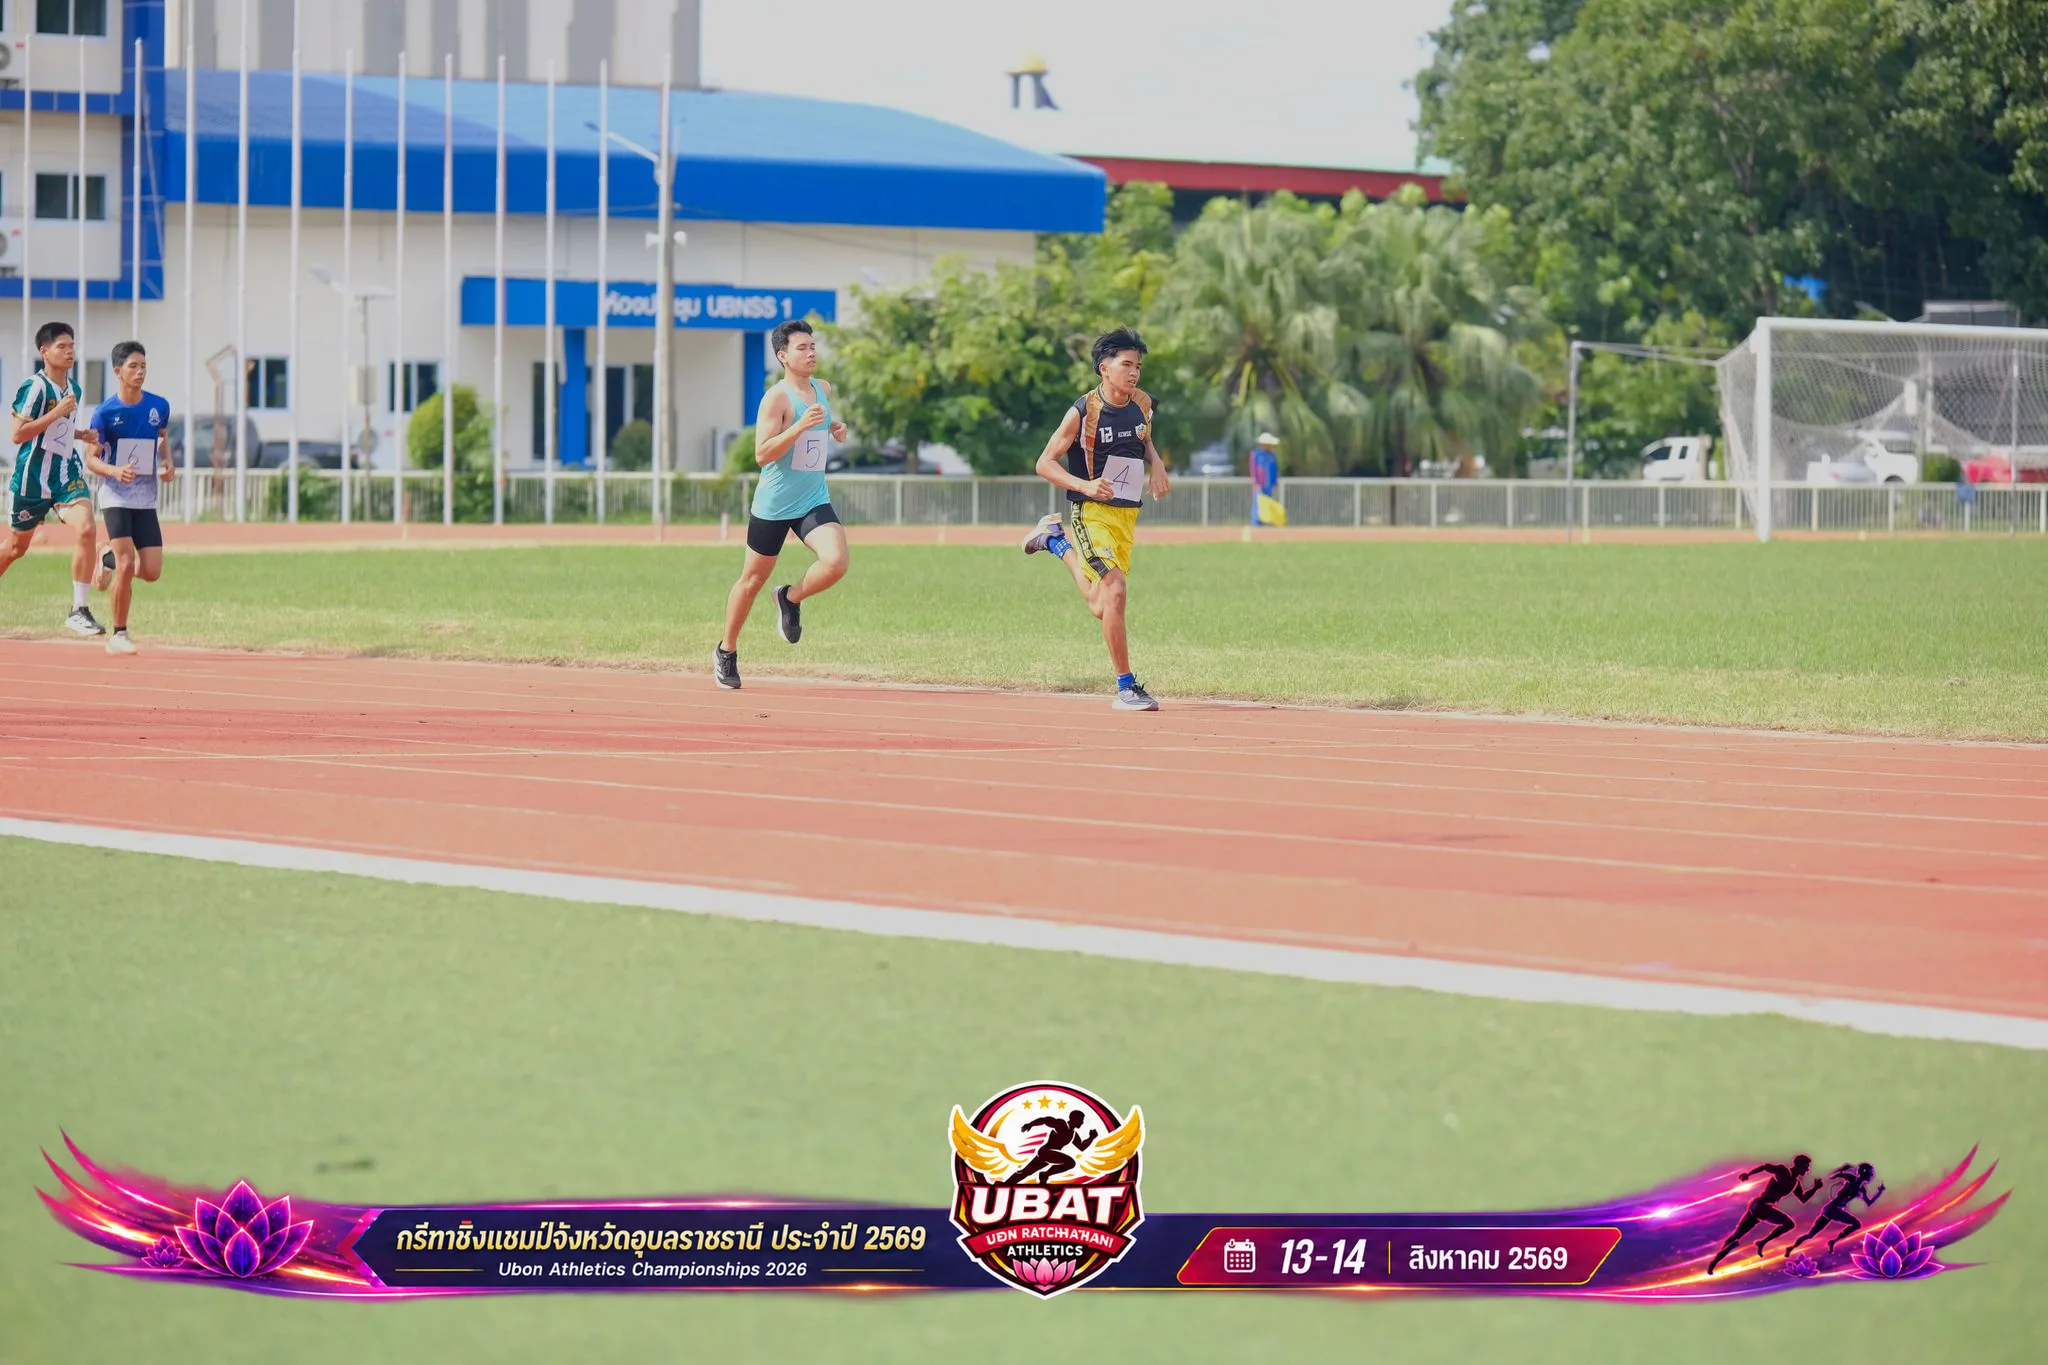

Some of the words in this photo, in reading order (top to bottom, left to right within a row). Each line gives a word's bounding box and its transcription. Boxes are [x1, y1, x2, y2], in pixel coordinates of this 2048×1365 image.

[53, 422, 69, 446] 2
[127, 444, 139, 466] 6
[805, 439, 821, 468] 5
[1112, 464, 1130, 492] 4
